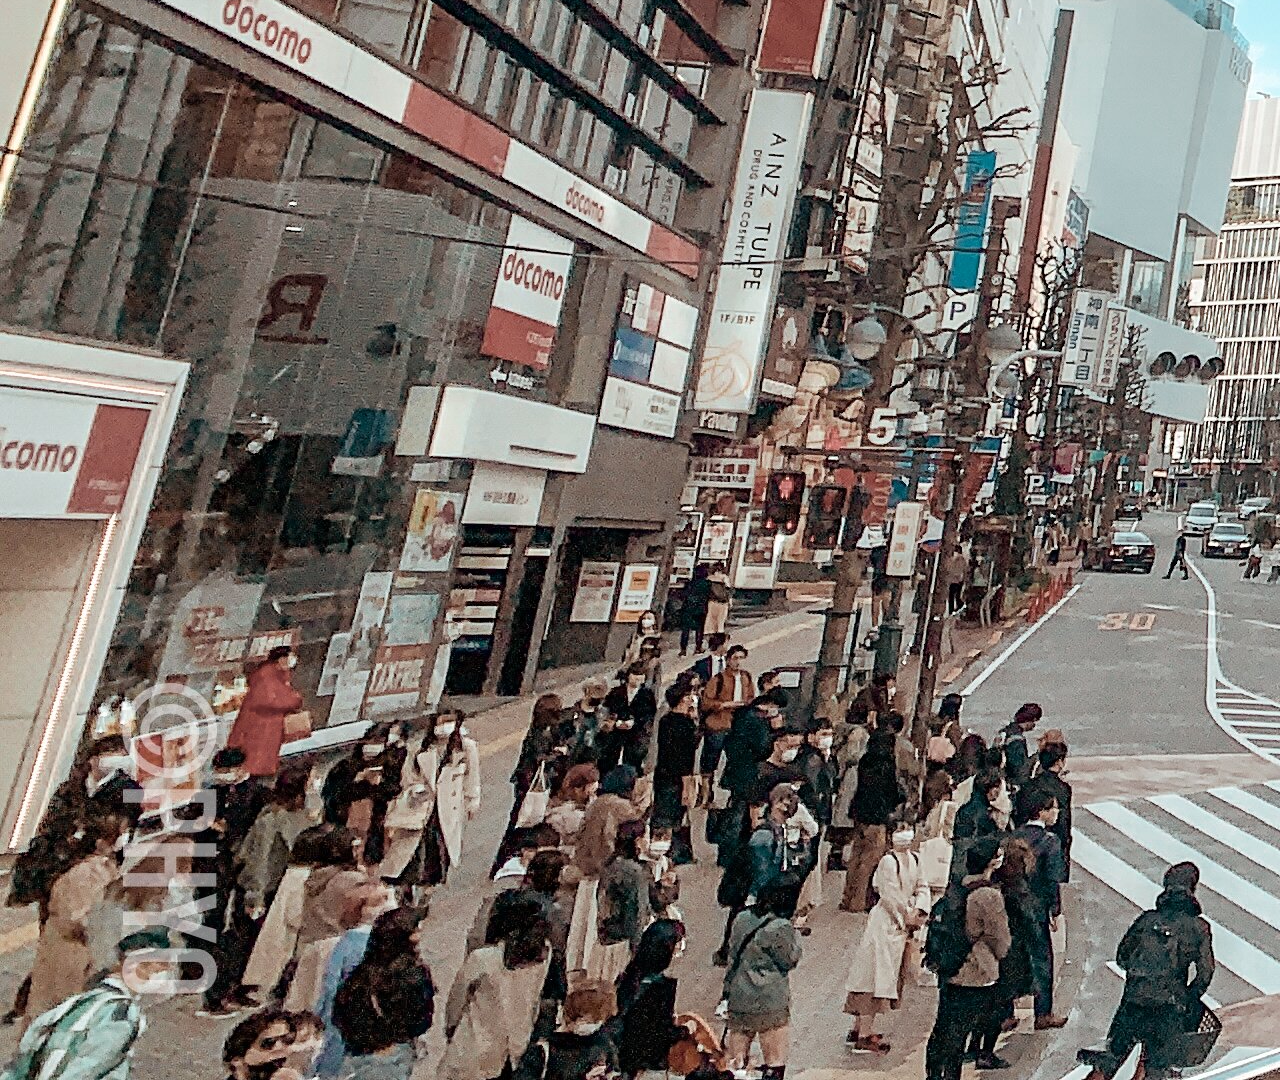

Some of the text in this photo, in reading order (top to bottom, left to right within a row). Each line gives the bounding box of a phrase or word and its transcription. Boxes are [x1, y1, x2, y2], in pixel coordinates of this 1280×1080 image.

[749, 149, 763, 181] DRUG
[565, 182, 605, 223] docomo
[743, 133, 787, 290] AINZ TULPE
[503, 250, 565, 301] docomo
[1076, 297, 1102, 380] 神南一丁目
[0, 439, 77, 473] como
